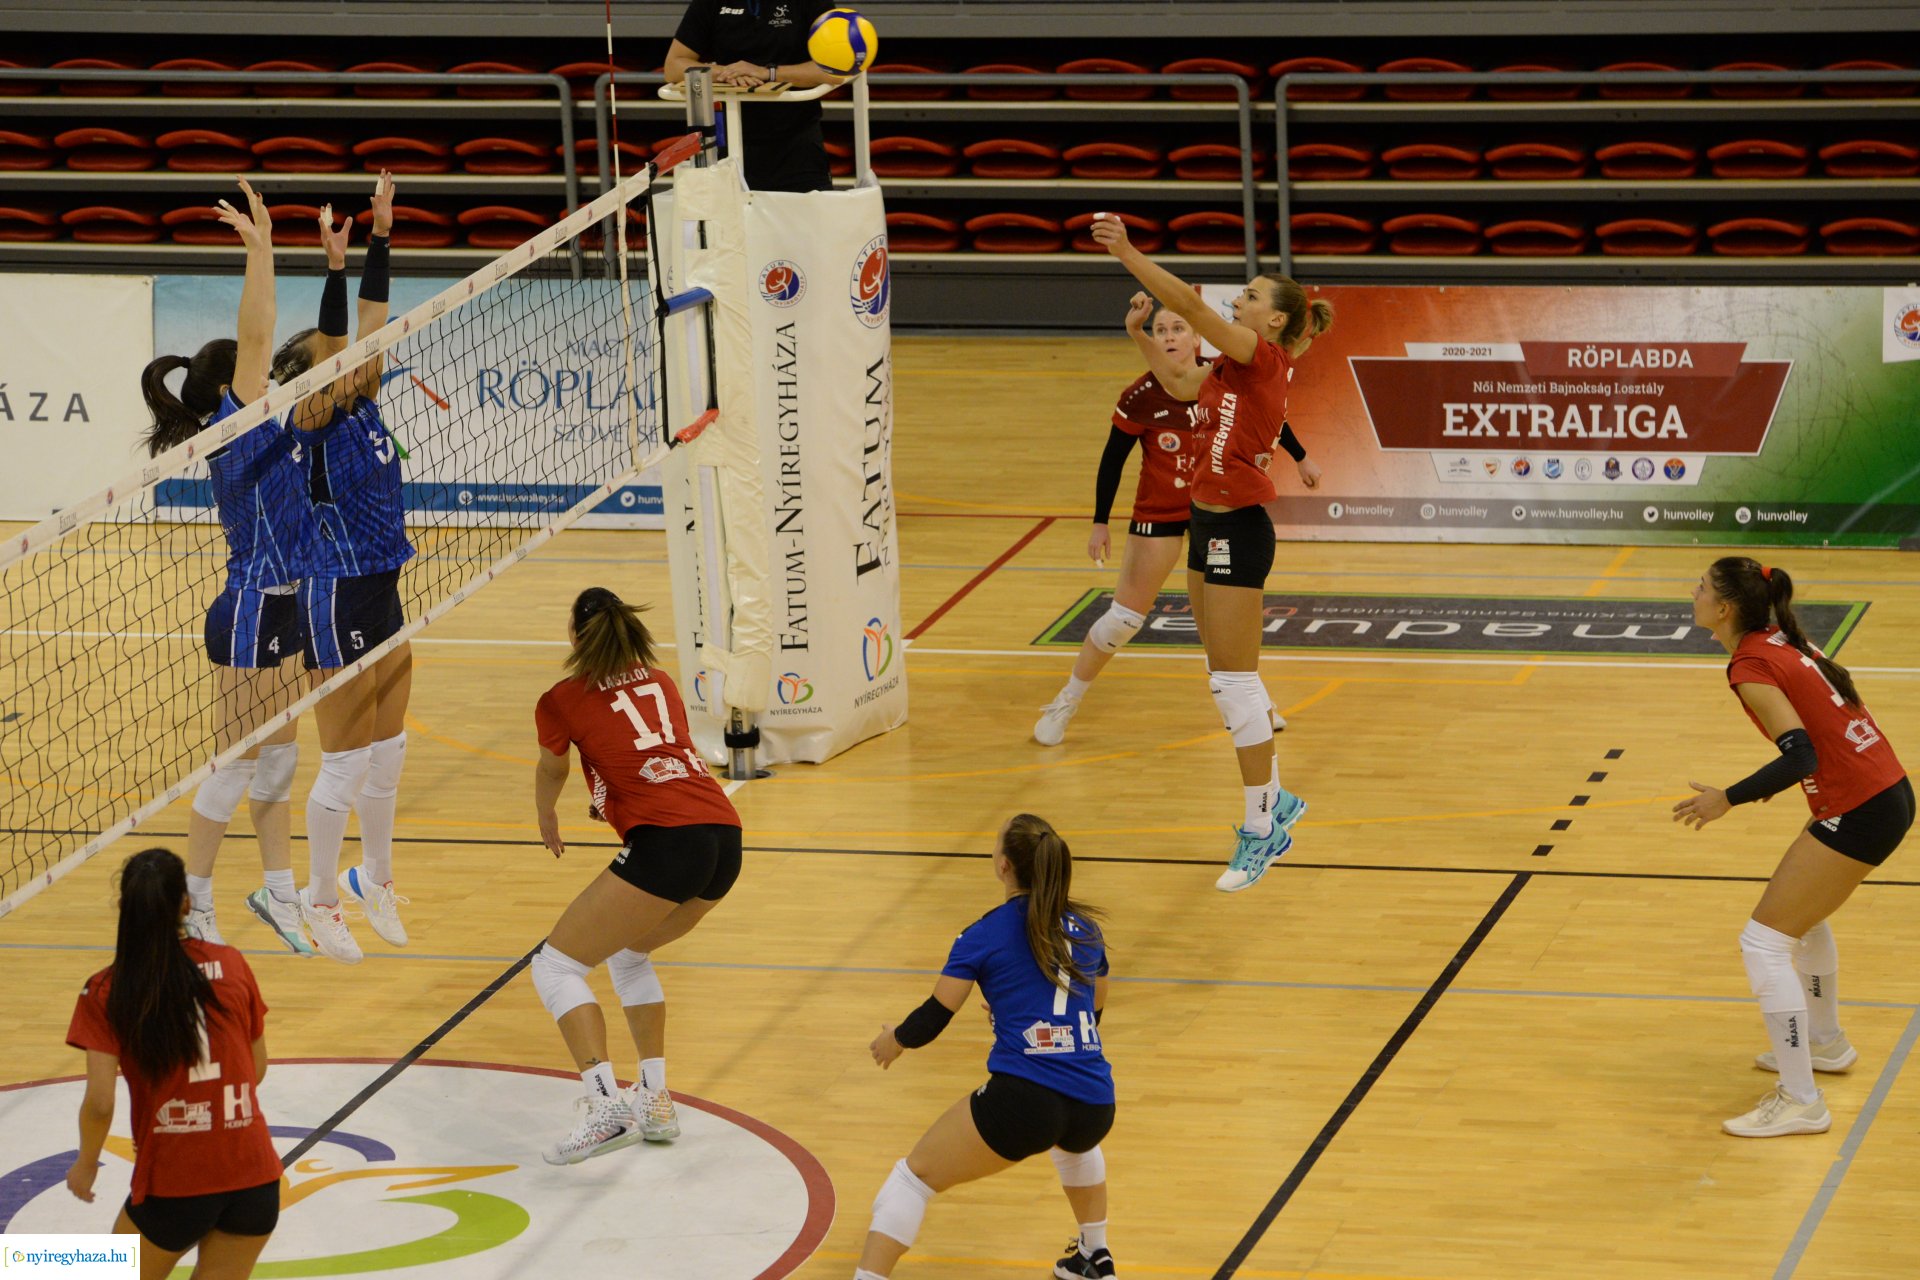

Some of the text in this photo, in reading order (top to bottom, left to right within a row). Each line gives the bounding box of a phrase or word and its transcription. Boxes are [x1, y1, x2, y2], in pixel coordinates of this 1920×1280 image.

[1442, 347, 1492, 357] 2020-2021
[1567, 345, 1694, 368] RÖPLABDA
[1473, 380, 1494, 394] Női
[1497, 381, 1547, 394] Nemzeti
[1549, 382, 1612, 398] Bajnokság
[1153, 409, 1169, 419] JAKO
[1442, 403, 1688, 439] EXTRALIGA
[1210, 392, 1238, 476] NYÍREGYHÁZA
[1345, 504, 1394, 518] hunvolley
[1438, 505, 1488, 519] hunvolley
[1530, 507, 1624, 521] www.hunvolley.hu
[1663, 508, 1714, 523] hunvolley
[1757, 509, 1808, 524] hunvolley
[1213, 567, 1231, 575] JAKO
[268, 636, 280, 654] 4
[350, 630, 365, 650] 5
[854, 675, 900, 710] NYÍREGYHÁZA
[610, 682, 676, 751] 17
[770, 705, 823, 717] NYÍREGYHÁZA
[1079, 1011, 1099, 1044] H
[1785, 1015, 1799, 1048] MIKASA
[223, 1082, 253, 1121] H
